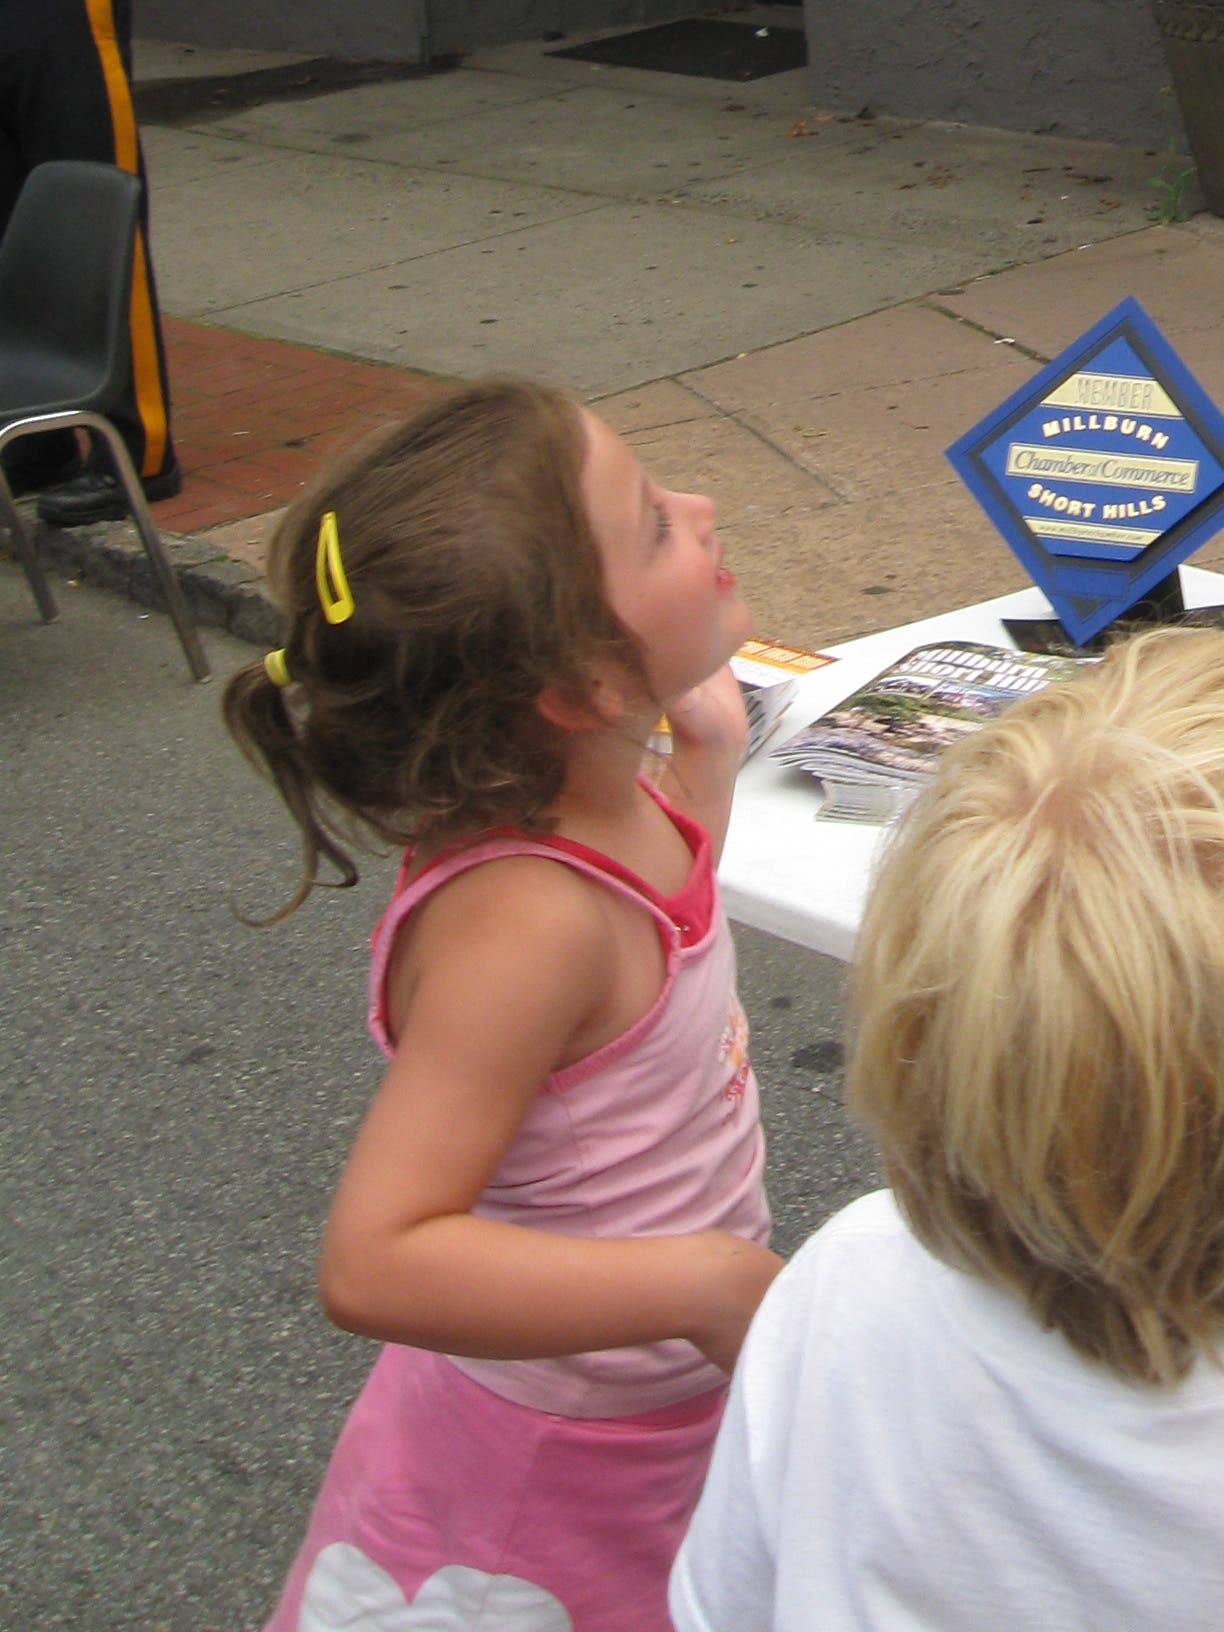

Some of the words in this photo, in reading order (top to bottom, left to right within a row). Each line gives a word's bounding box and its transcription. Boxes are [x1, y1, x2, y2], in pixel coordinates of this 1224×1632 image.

[1075, 378, 1154, 410] MEMBER
[1041, 414, 1170, 451] MILLBURN
[1014, 450, 1092, 476] Chamber
[1099, 459, 1190, 488] Commerce
[1027, 483, 1096, 519] SHORT
[1101, 494, 1168, 520] HILLS
